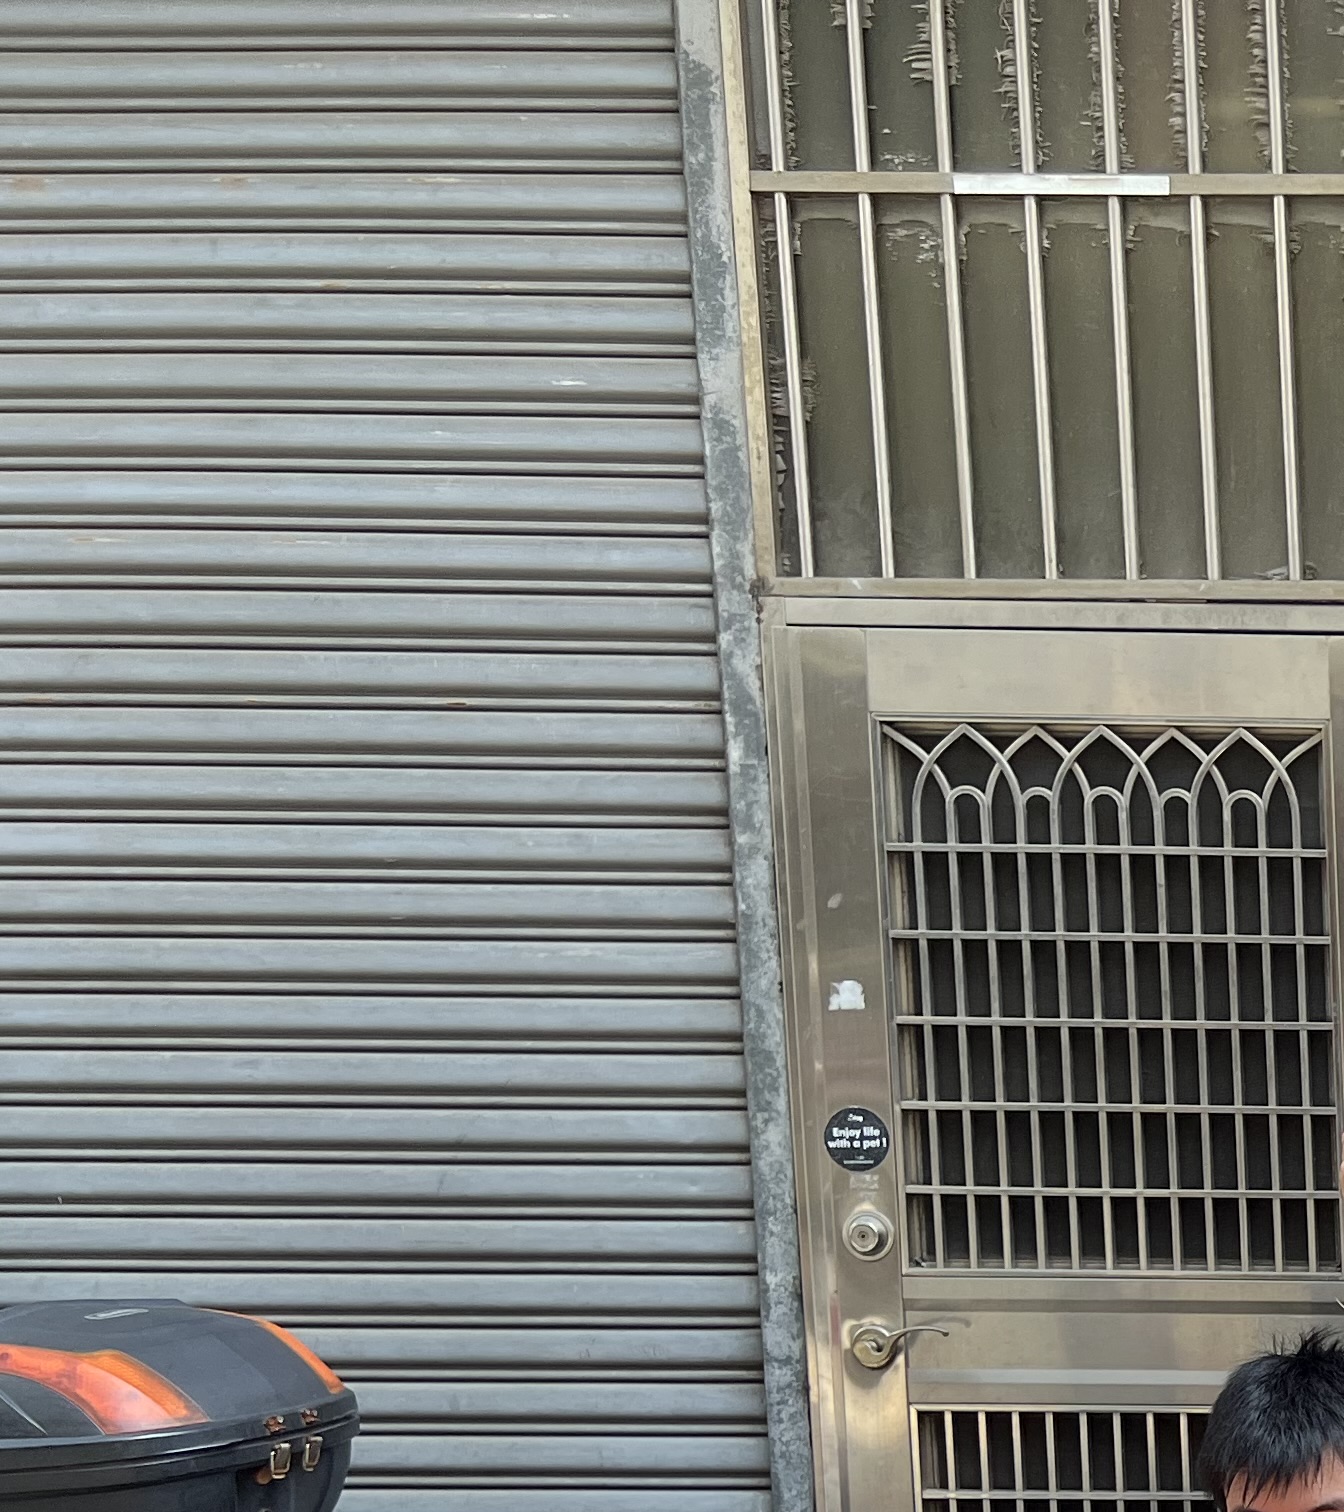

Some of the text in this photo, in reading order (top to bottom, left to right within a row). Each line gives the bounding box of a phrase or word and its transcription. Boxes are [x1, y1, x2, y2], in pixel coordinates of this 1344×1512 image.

[832, 1126, 881, 1139] Enjoy life
[827, 1138, 851, 1149] with
[863, 1138, 880, 1150] pet
